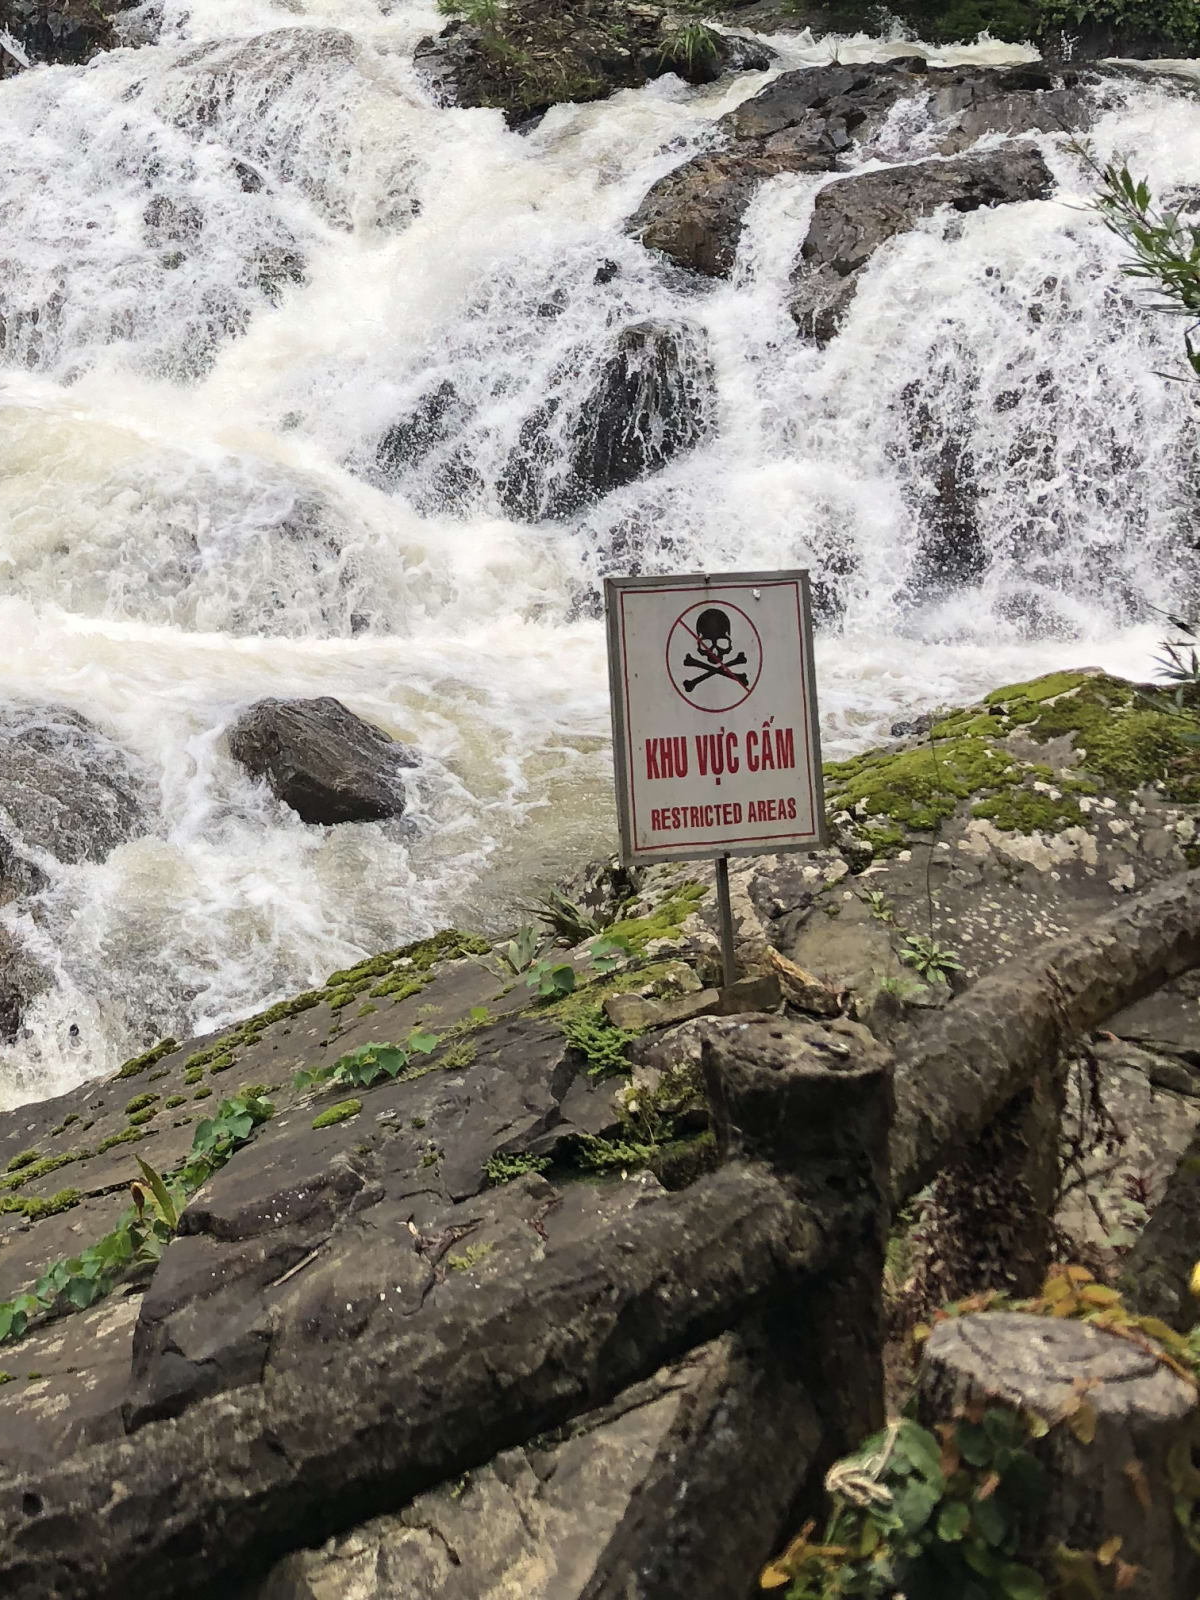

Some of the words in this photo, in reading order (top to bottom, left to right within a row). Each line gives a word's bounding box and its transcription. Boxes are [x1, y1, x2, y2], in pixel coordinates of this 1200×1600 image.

[645, 737, 688, 780] KHU
[696, 726, 739, 786] VỰC
[746, 716, 795, 772] CẤM
[651, 803, 742, 831] RESTRICTED
[748, 797, 797, 823] AREAS
